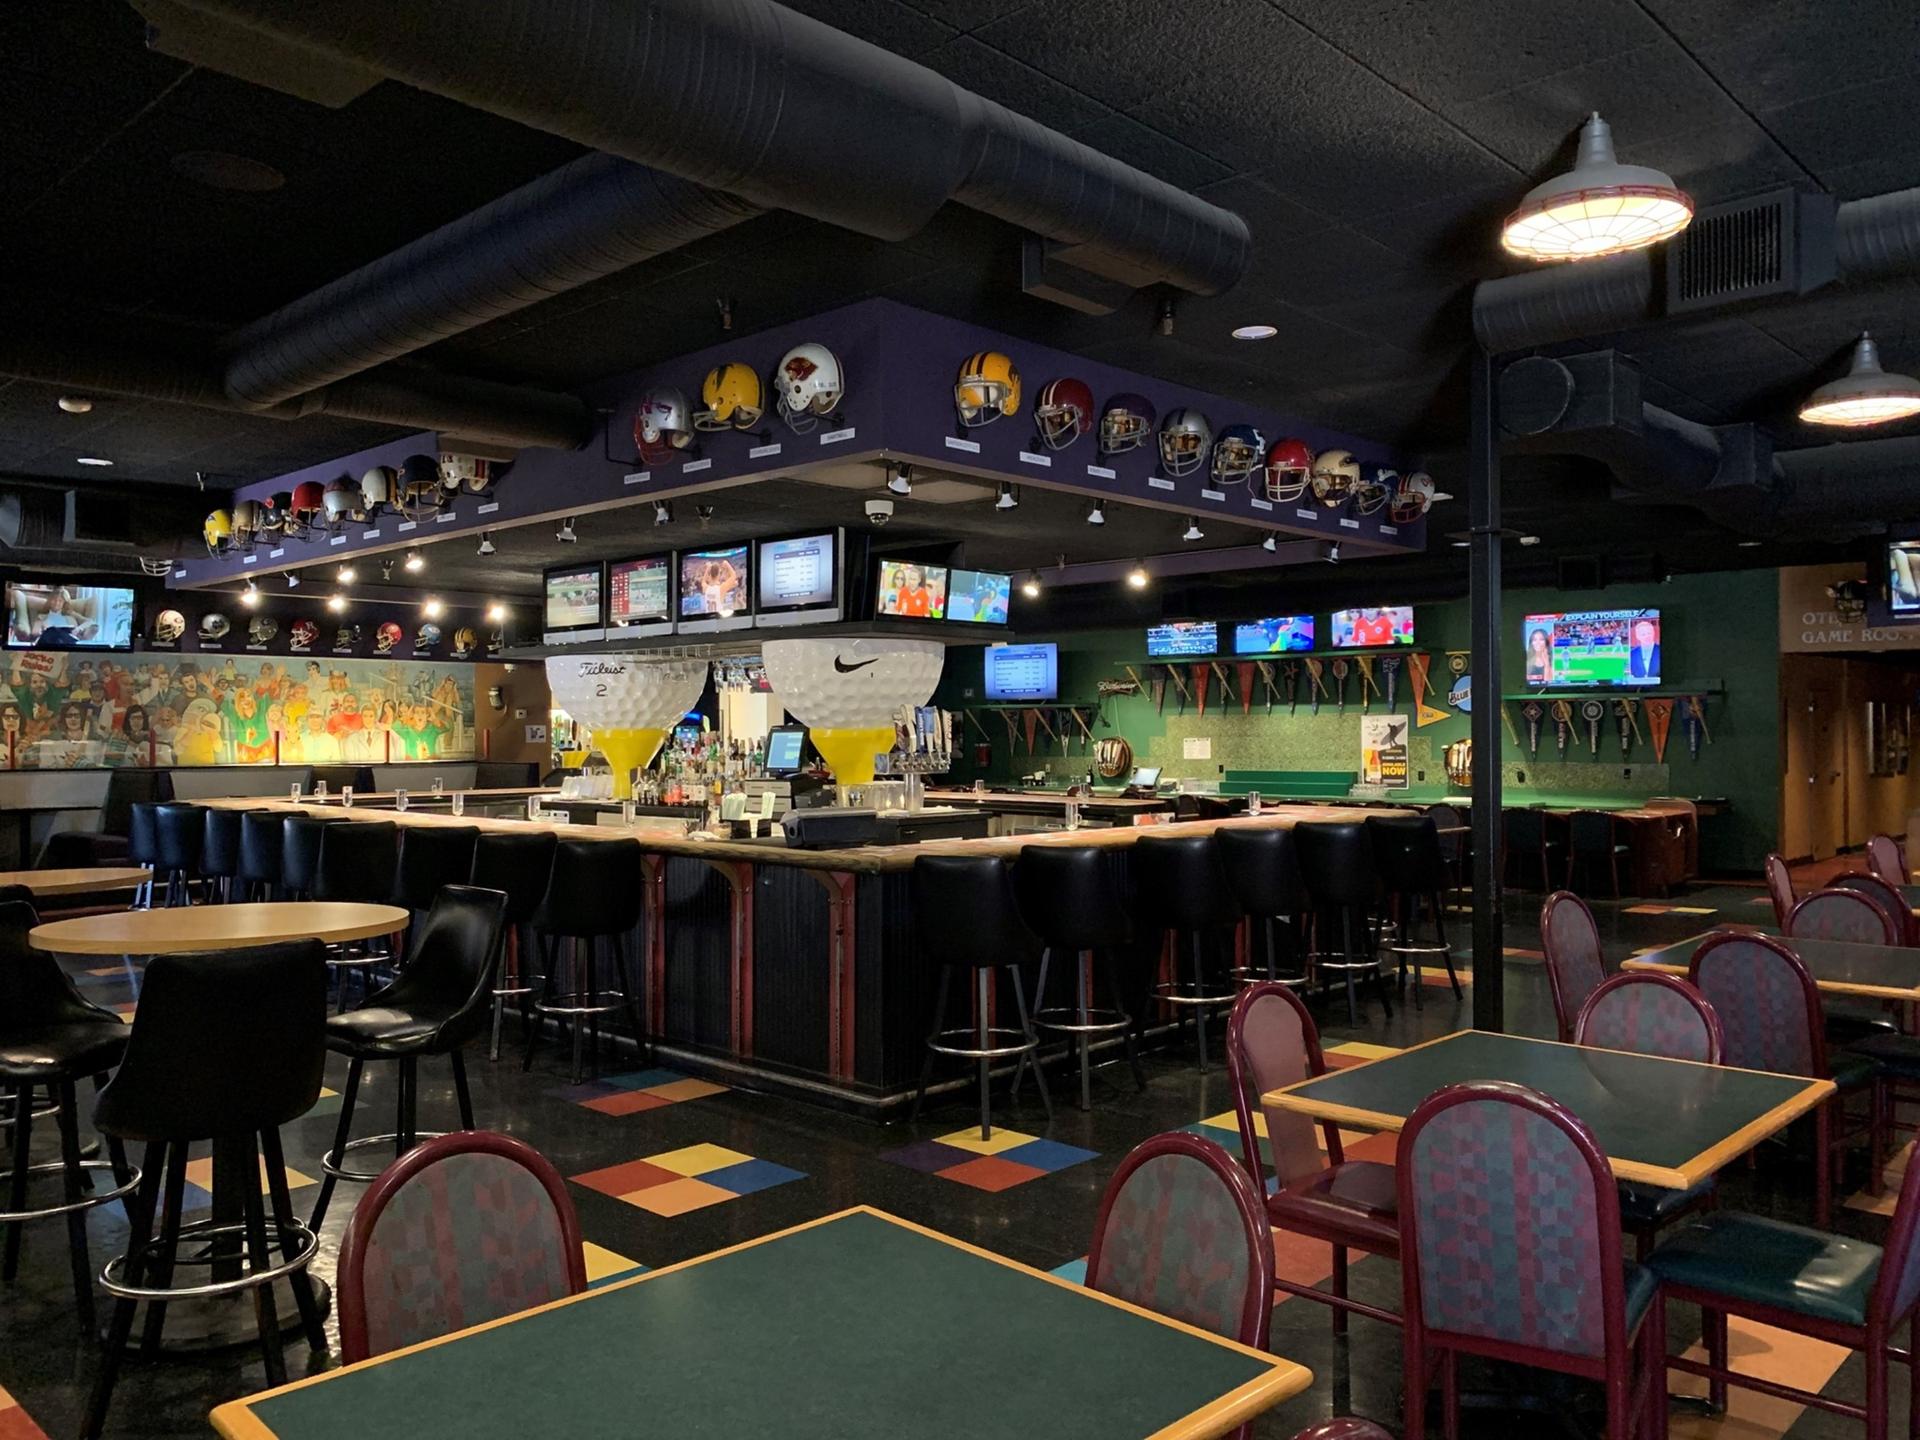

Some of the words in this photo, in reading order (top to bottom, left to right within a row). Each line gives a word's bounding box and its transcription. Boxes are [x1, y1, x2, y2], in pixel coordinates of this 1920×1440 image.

[1566, 611, 1598, 620] EXPLAIN
[1600, 609, 1639, 619] YOURSELF
[1802, 629, 1852, 644] GAME
[1861, 628, 1914, 642] ROO
[596, 683, 608, 697] 2
[1382, 767, 1406, 776] NOW
